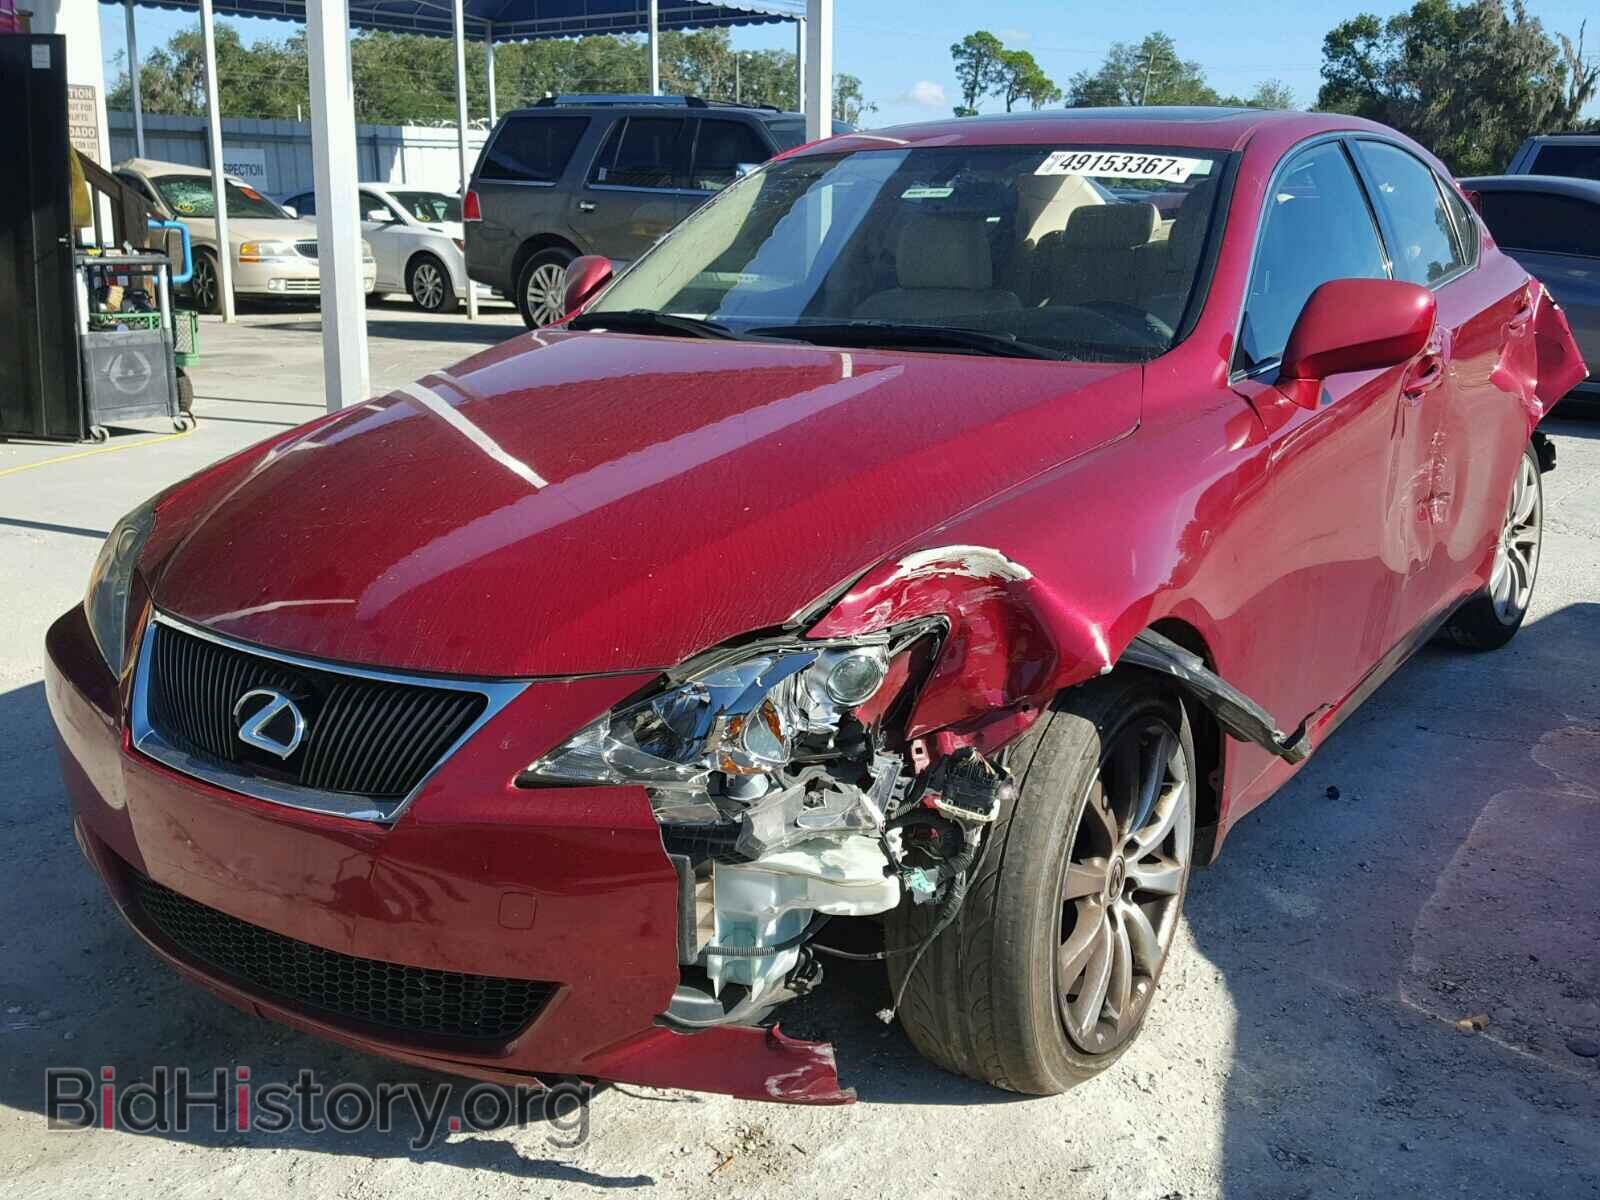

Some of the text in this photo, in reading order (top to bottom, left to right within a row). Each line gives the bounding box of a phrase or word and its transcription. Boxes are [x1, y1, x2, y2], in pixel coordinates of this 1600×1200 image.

[68, 88, 93, 99] TION
[69, 127, 95, 137] DADO
[223, 163, 264, 176] SPECTION
